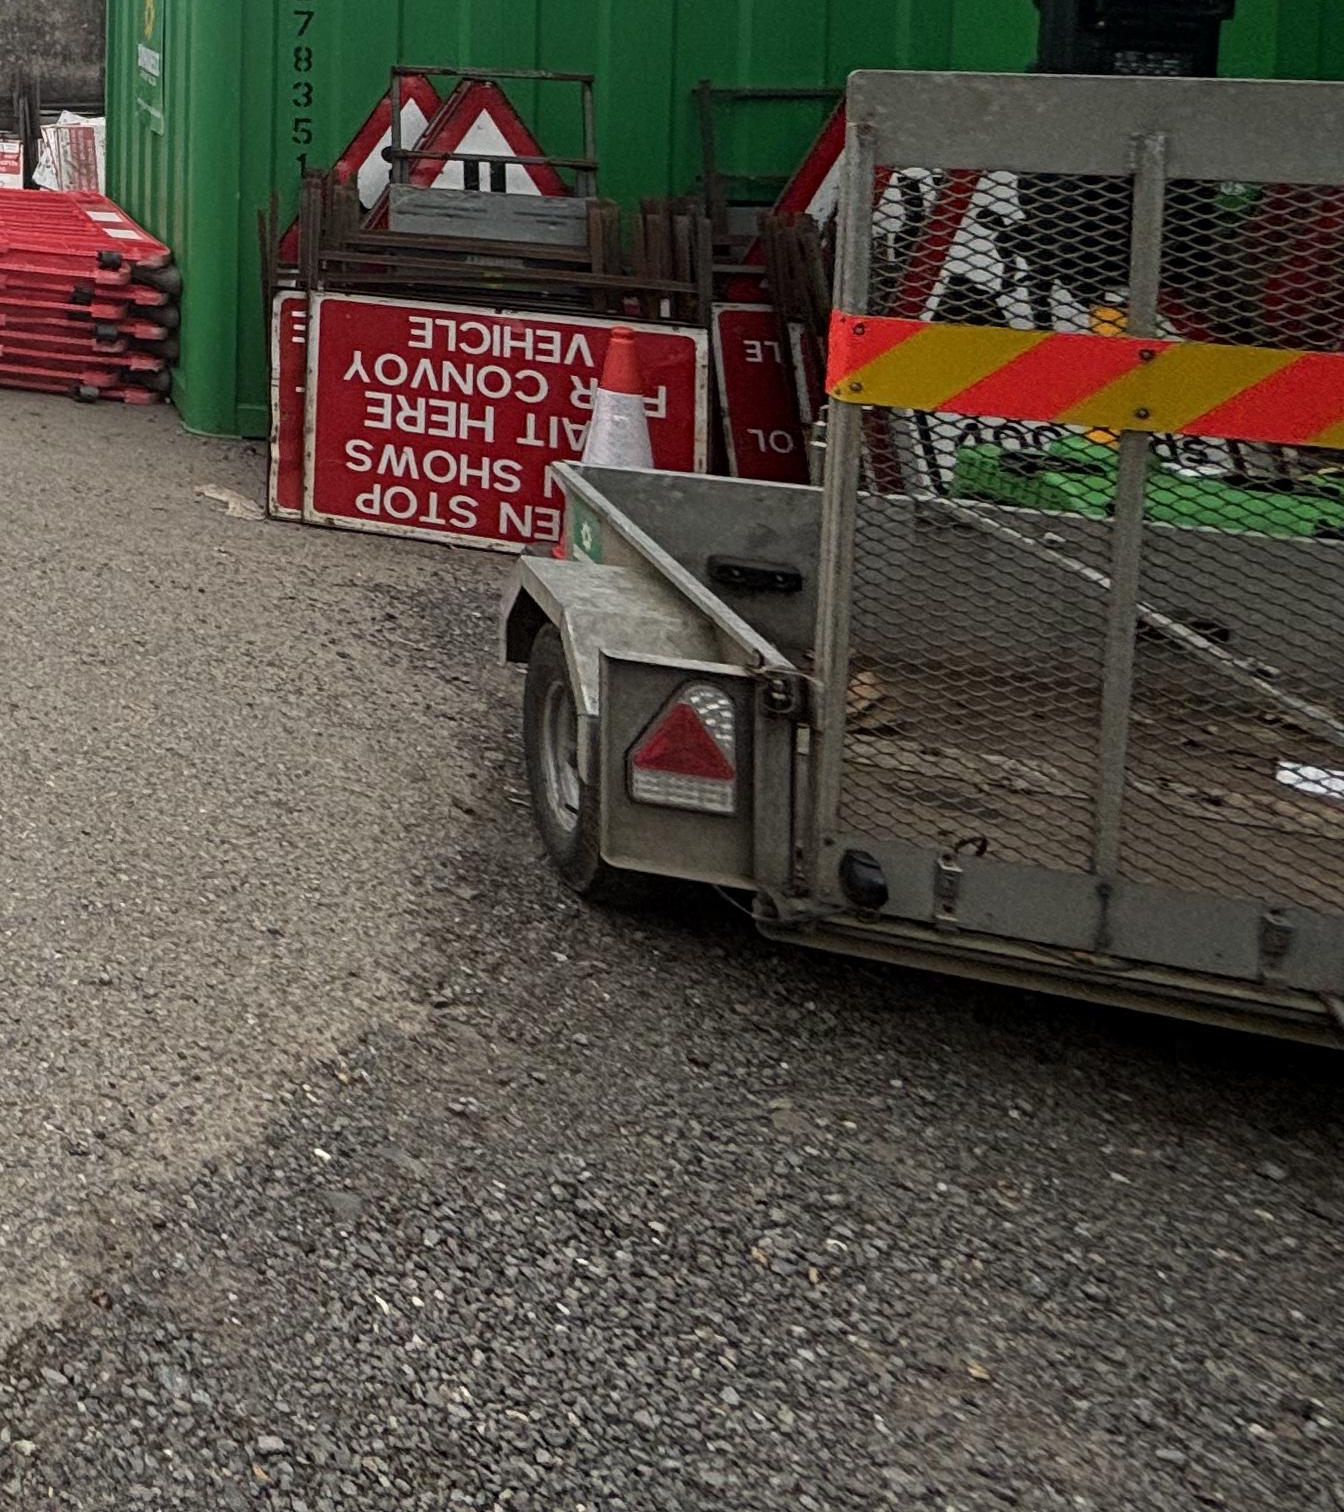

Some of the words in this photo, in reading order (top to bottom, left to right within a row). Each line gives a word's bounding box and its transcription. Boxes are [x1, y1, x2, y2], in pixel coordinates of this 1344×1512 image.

[407, 315, 595, 368] VEHICLE
[343, 350, 549, 404] CONVOY
[569, 375, 667, 418] FR
[363, 390, 495, 443] HERE
[516, 412, 592, 452] AIT
[344, 439, 523, 493] SHOWS
[354, 483, 479, 529] STOP
[498, 501, 561, 542] EN
